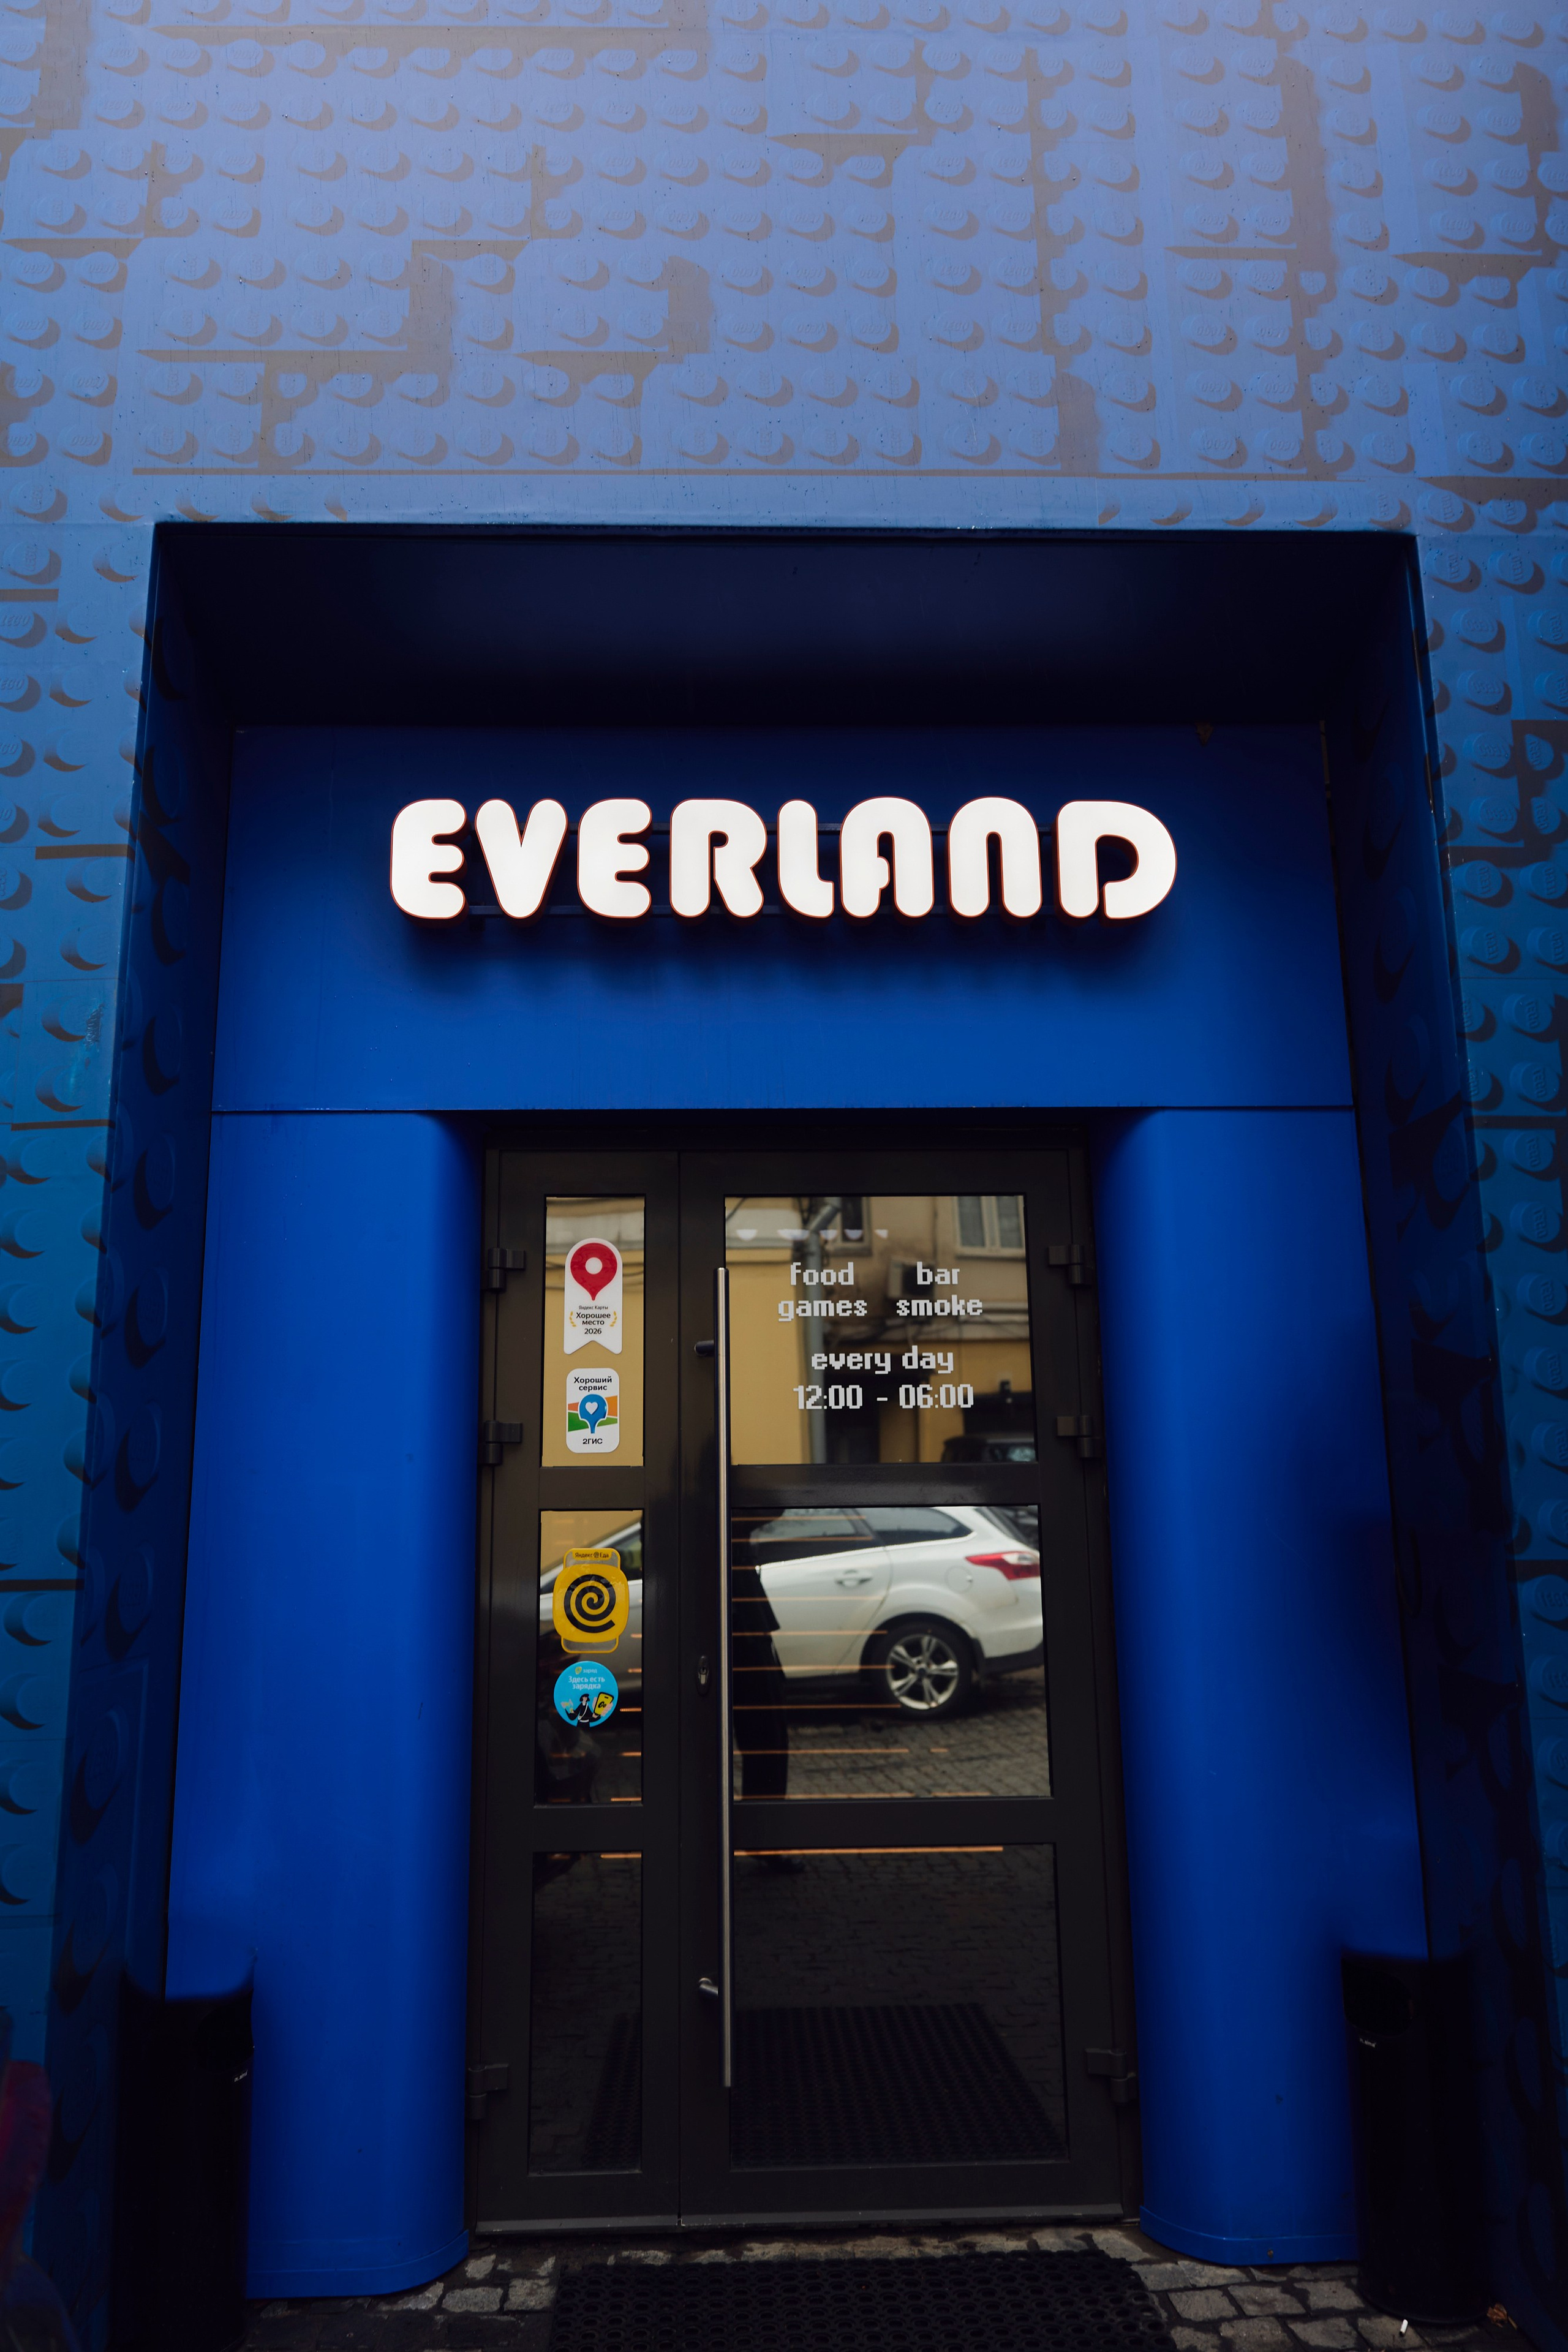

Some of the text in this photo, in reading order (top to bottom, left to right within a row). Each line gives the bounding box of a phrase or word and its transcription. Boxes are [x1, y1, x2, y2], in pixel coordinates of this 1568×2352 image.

[390, 796, 1178, 919] EVERLAND
[791, 1262, 960, 1285] food bar
[778, 1295, 982, 1322] games smoke
[812, 1345, 954, 1374] every day
[574, 1376, 612, 1384] Хороший
[793, 1385, 862, 1409] 12:00
[899, 1384, 973, 1408] 06:00
